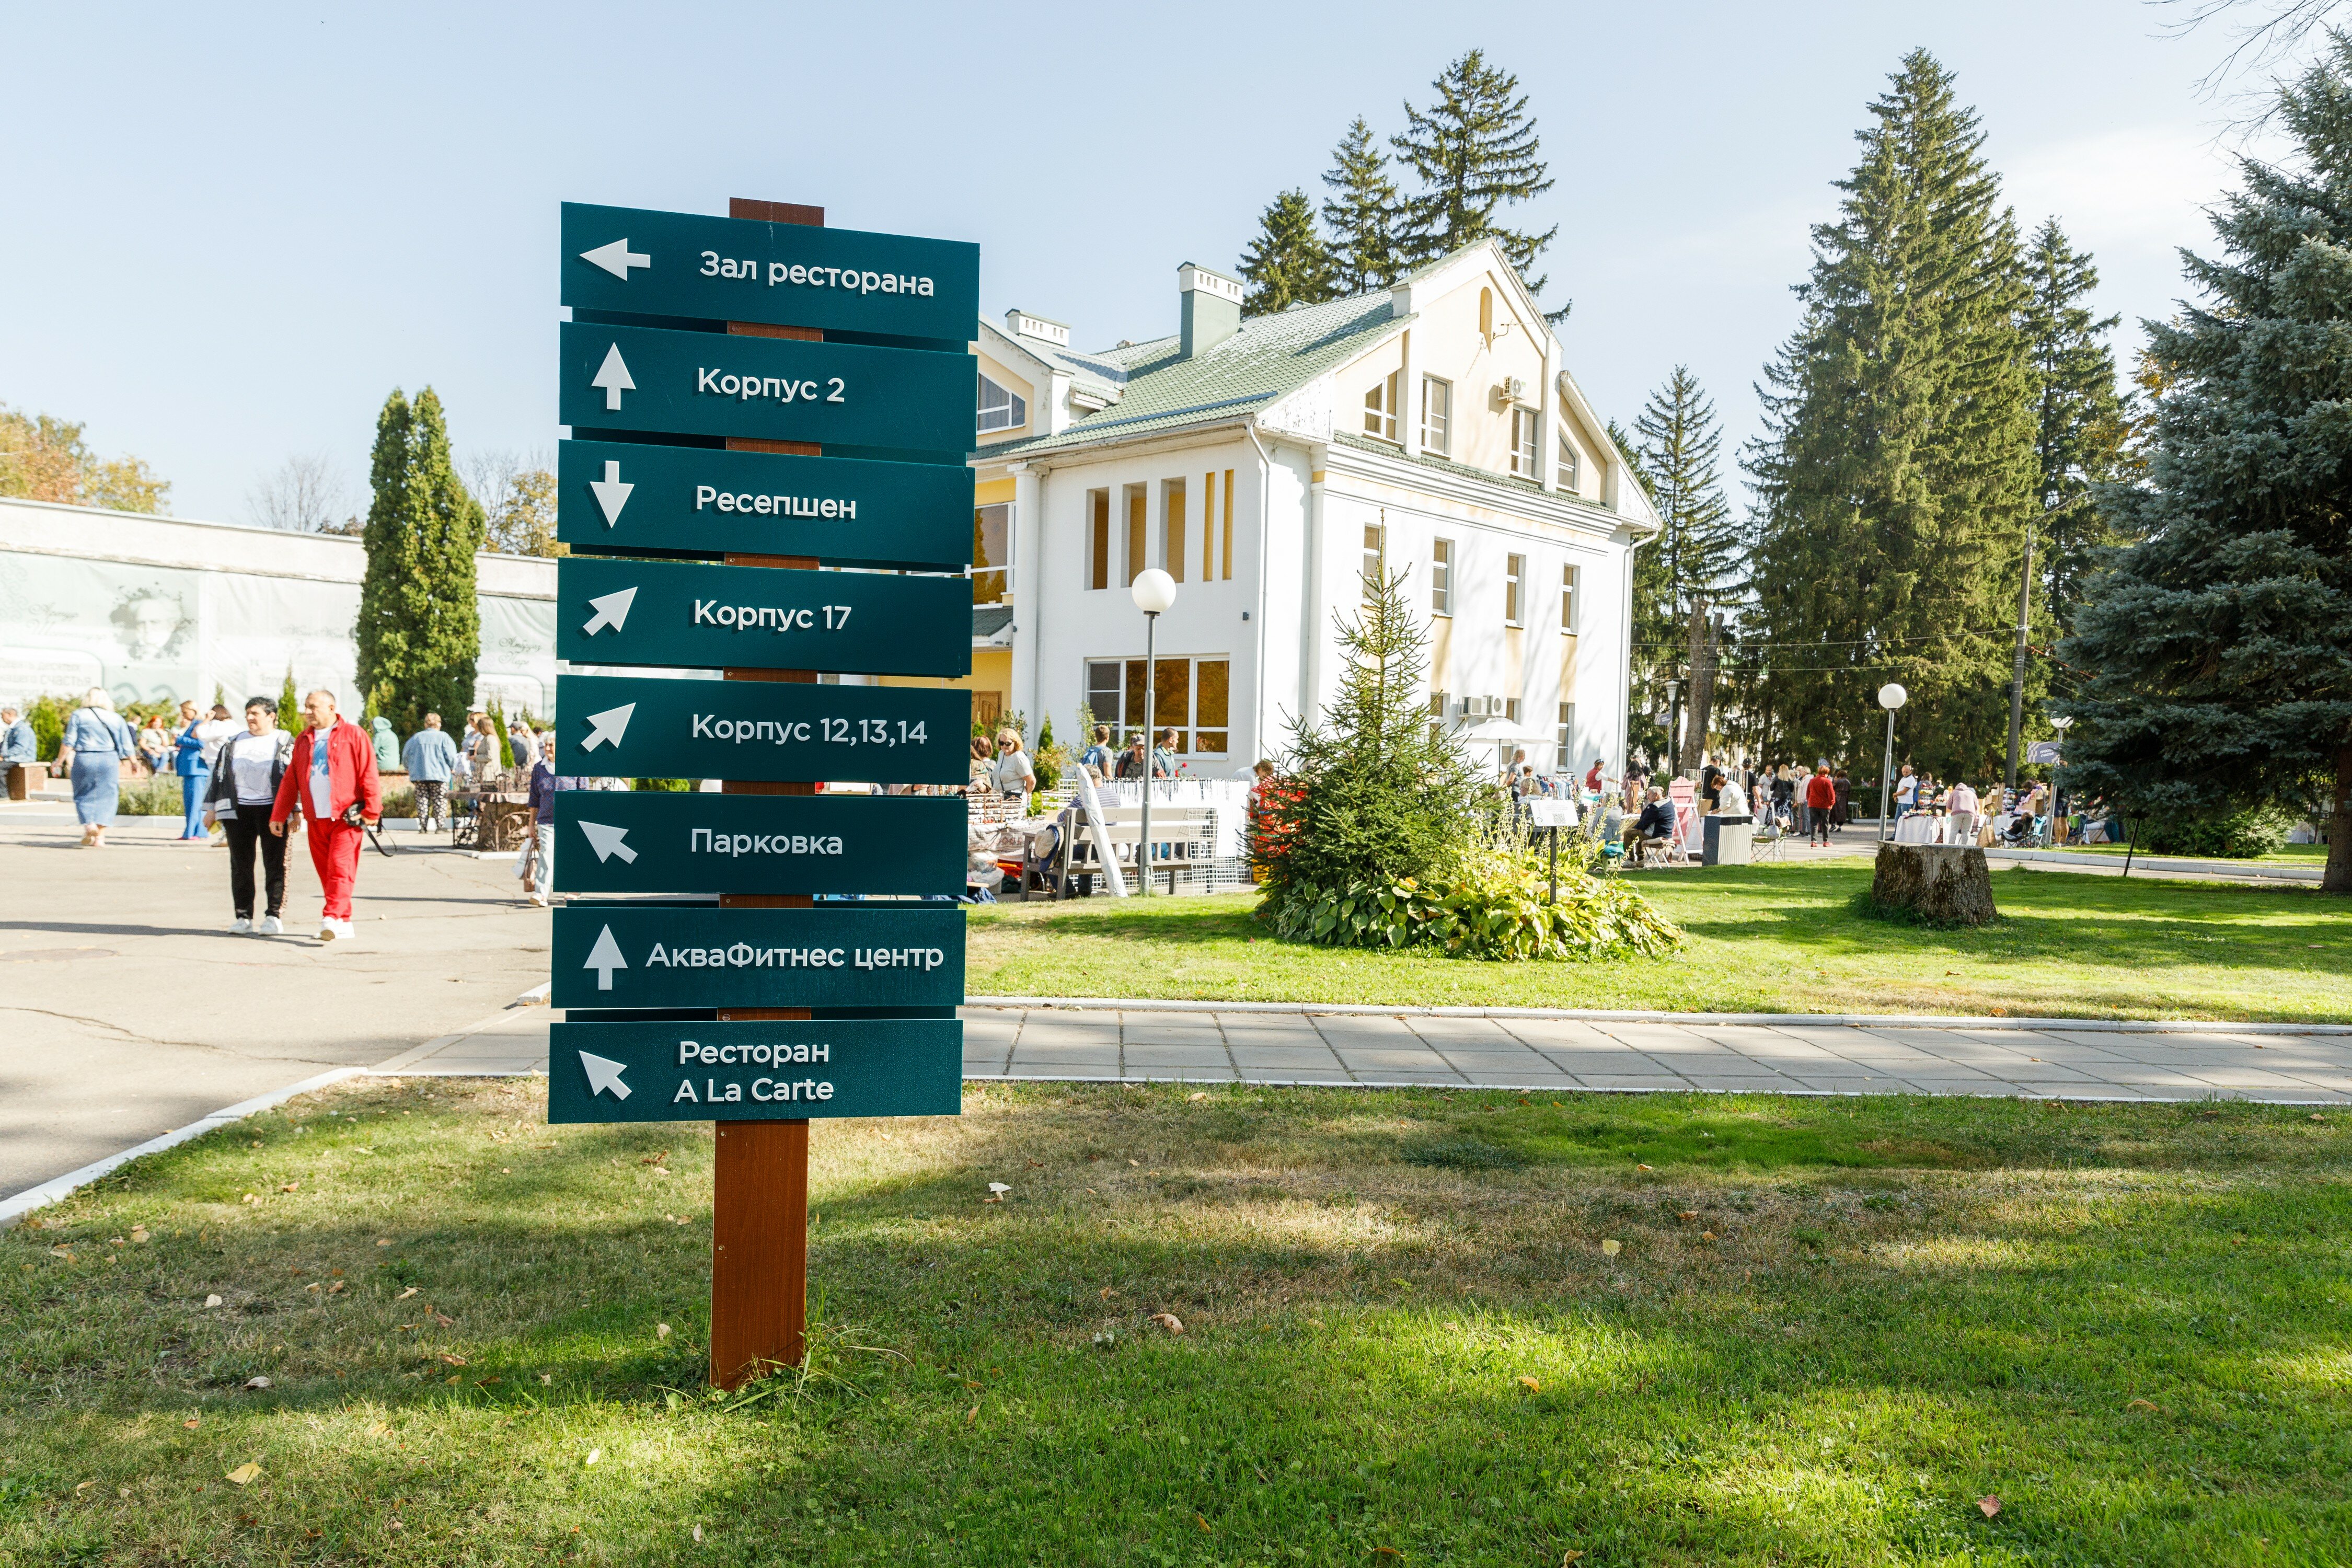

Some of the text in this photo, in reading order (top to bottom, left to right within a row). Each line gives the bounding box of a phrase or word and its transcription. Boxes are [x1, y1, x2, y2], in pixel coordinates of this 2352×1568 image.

[700, 251, 933, 296] Зал ресторана
[699, 368, 844, 402] Корпус 2
[697, 486, 856, 519] Ресепшен
[695, 599, 851, 631] Корпус 17
[694, 714, 927, 747] Корпус 12,13,14
[692, 829, 842, 857] Парковка
[645, 942, 943, 971] АкваФитнес центр
[681, 1041, 828, 1068] Ресторан
[674, 1078, 834, 1102] A La Carte
